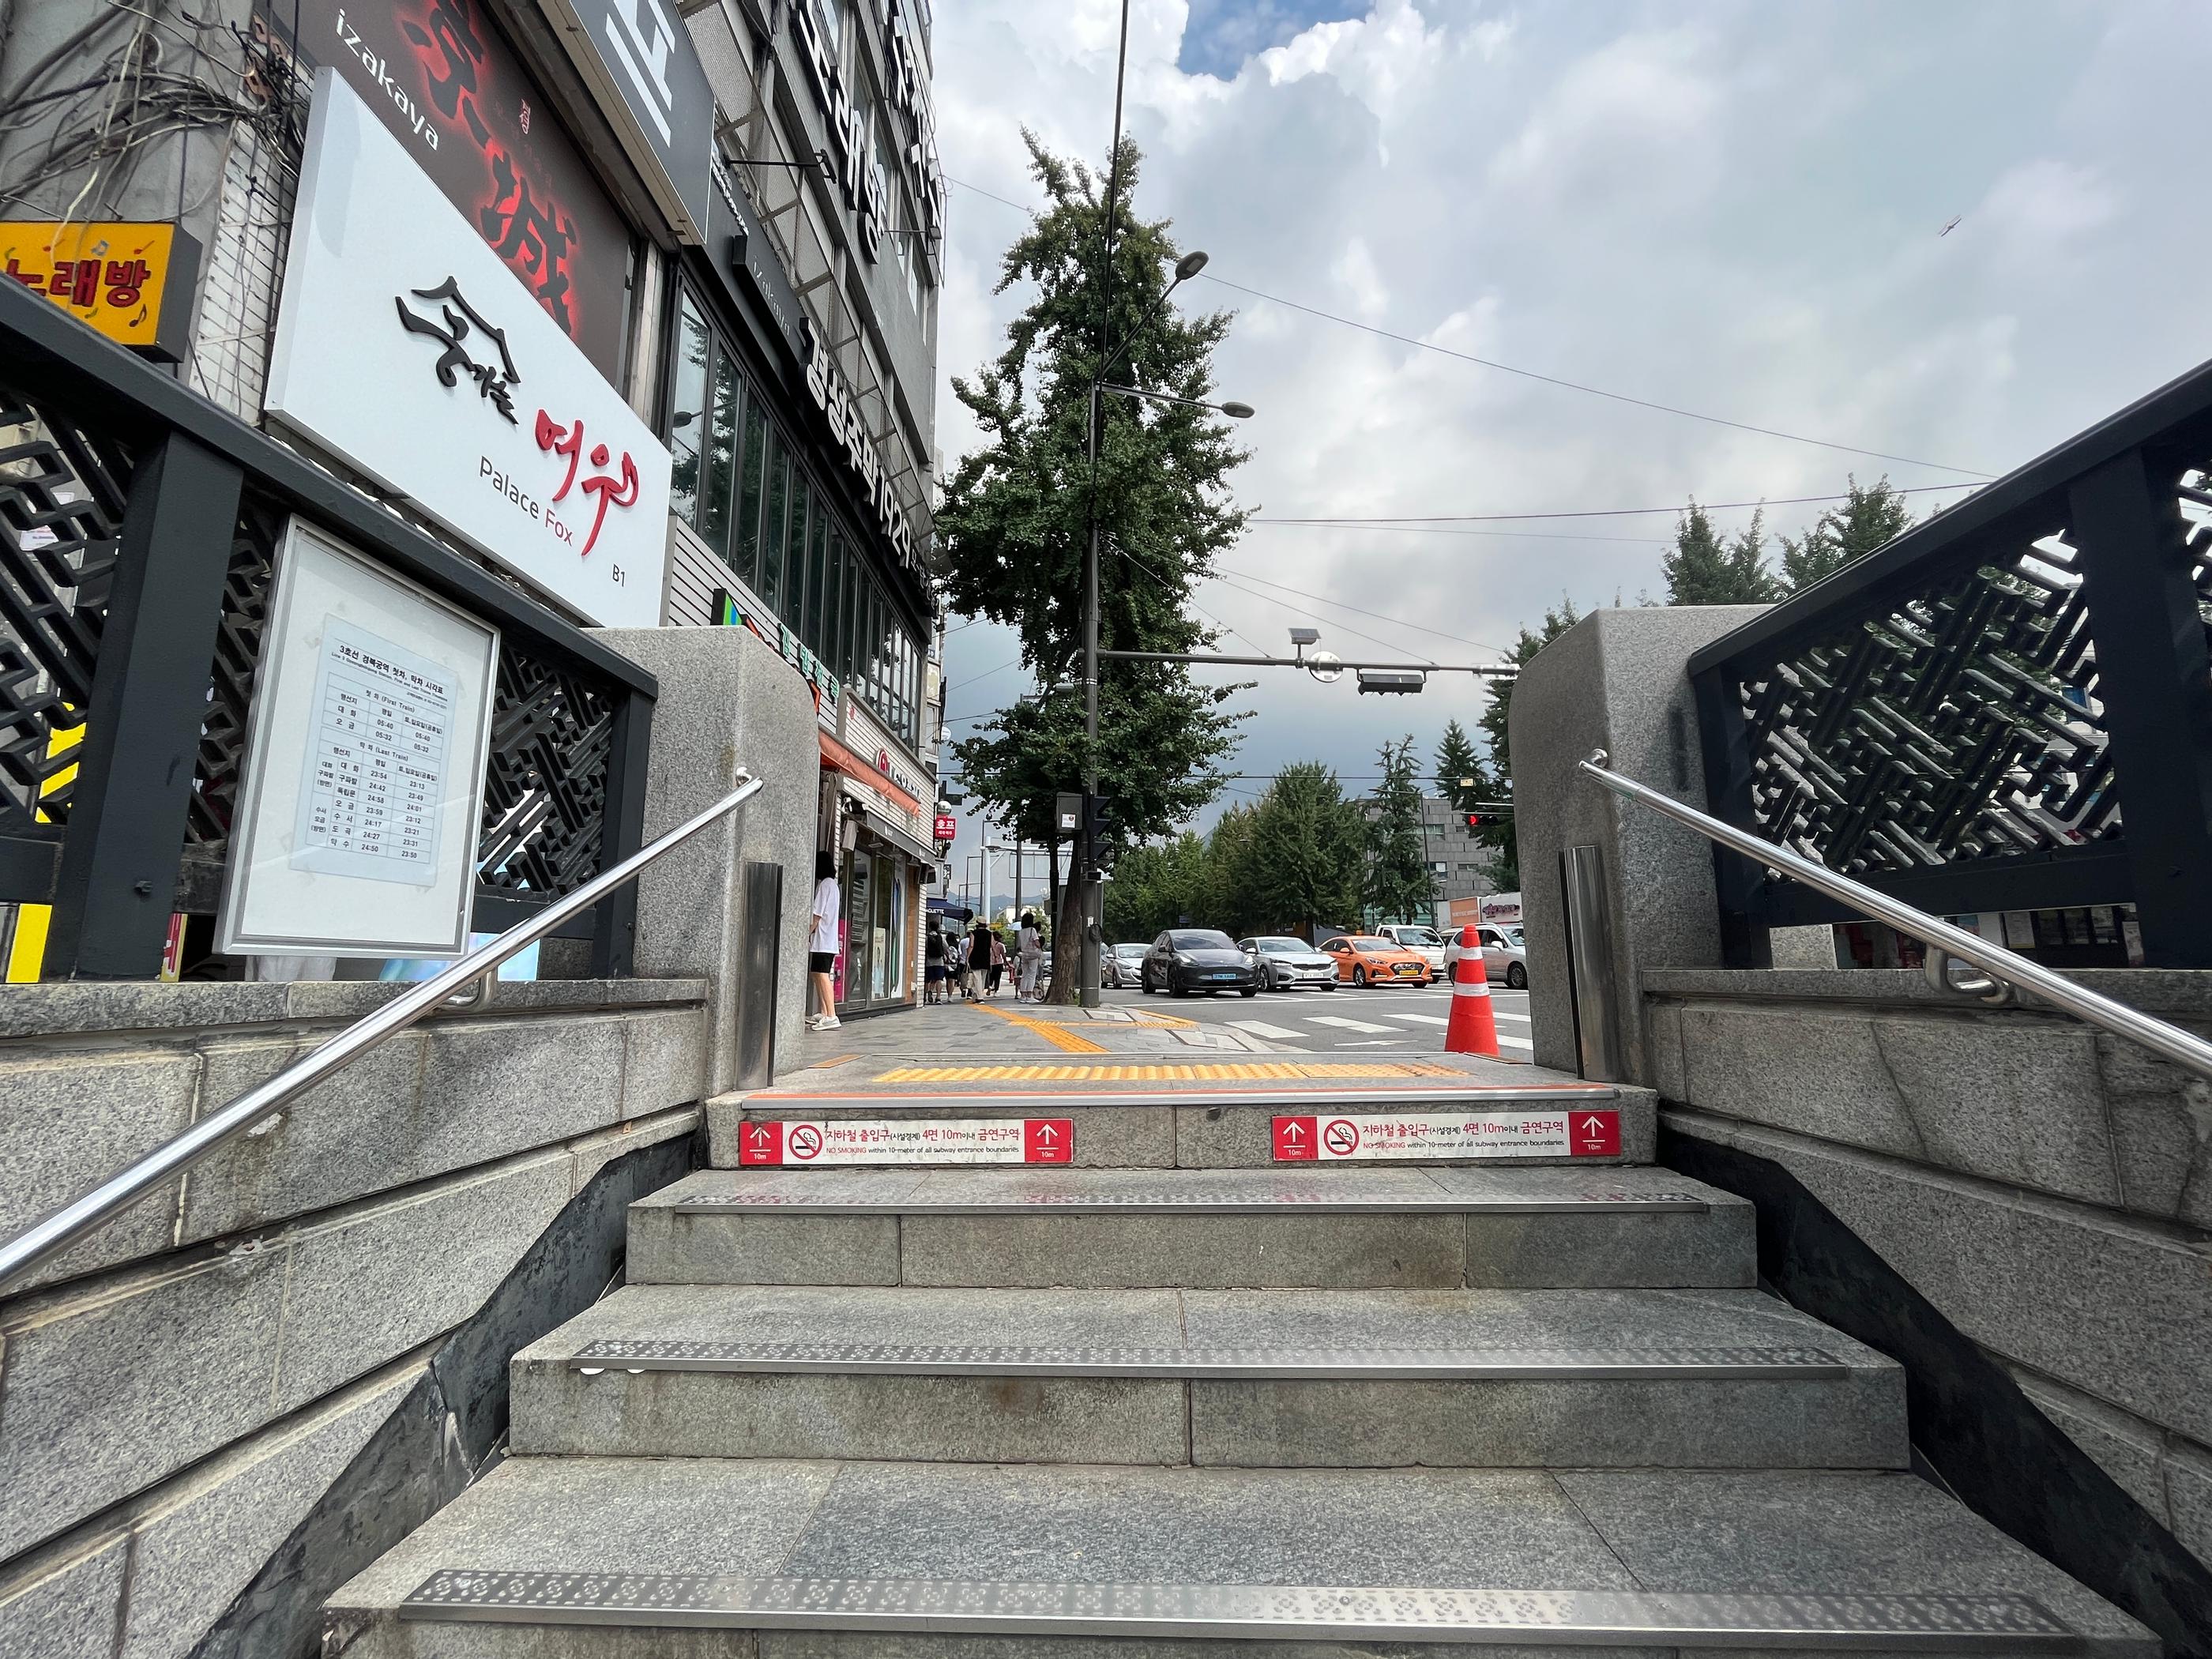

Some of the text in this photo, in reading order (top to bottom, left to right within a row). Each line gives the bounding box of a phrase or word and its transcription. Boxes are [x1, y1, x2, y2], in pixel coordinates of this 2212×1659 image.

[336, 9, 438, 150] izakaya
[6, 259, 152, 308] 노래방
[480, 455, 574, 547] Palace Fox
[611, 563, 626, 588] B1
[339, 645, 359, 660] 3호선
[363, 654, 389, 672] 경복궁역
[425, 681, 444, 694] 시각표
[377, 719, 393, 730] 05:40
[375, 731, 392, 741] 05:32
[415, 732, 431, 742] 05:40
[413, 743, 429, 753] 05:32
[371, 769, 388, 780] 23:54
[369, 782, 386, 792] 24:42
[409, 781, 425, 790] 23:13
[408, 792, 423, 801] 23:49
[366, 807, 383, 816] 23:59
[407, 803, 422, 812] 24:01
[364, 818, 382, 827] 24:17
[405, 815, 421, 824] 23:12
[363, 831, 381, 840] 24:27
[361, 844, 379, 852] 24:50
[1363, 1124, 1394, 1138] 지하철
[1463, 1122, 1480, 1135] 4면
[1520, 1120, 1563, 1134] 금연구역
[826, 1129, 856, 1142] 지하철
[922, 1128, 938, 1141] 4면
[977, 1128, 1021, 1141] 금연구역
[1375, 1141, 1405, 1149] SMOKING
